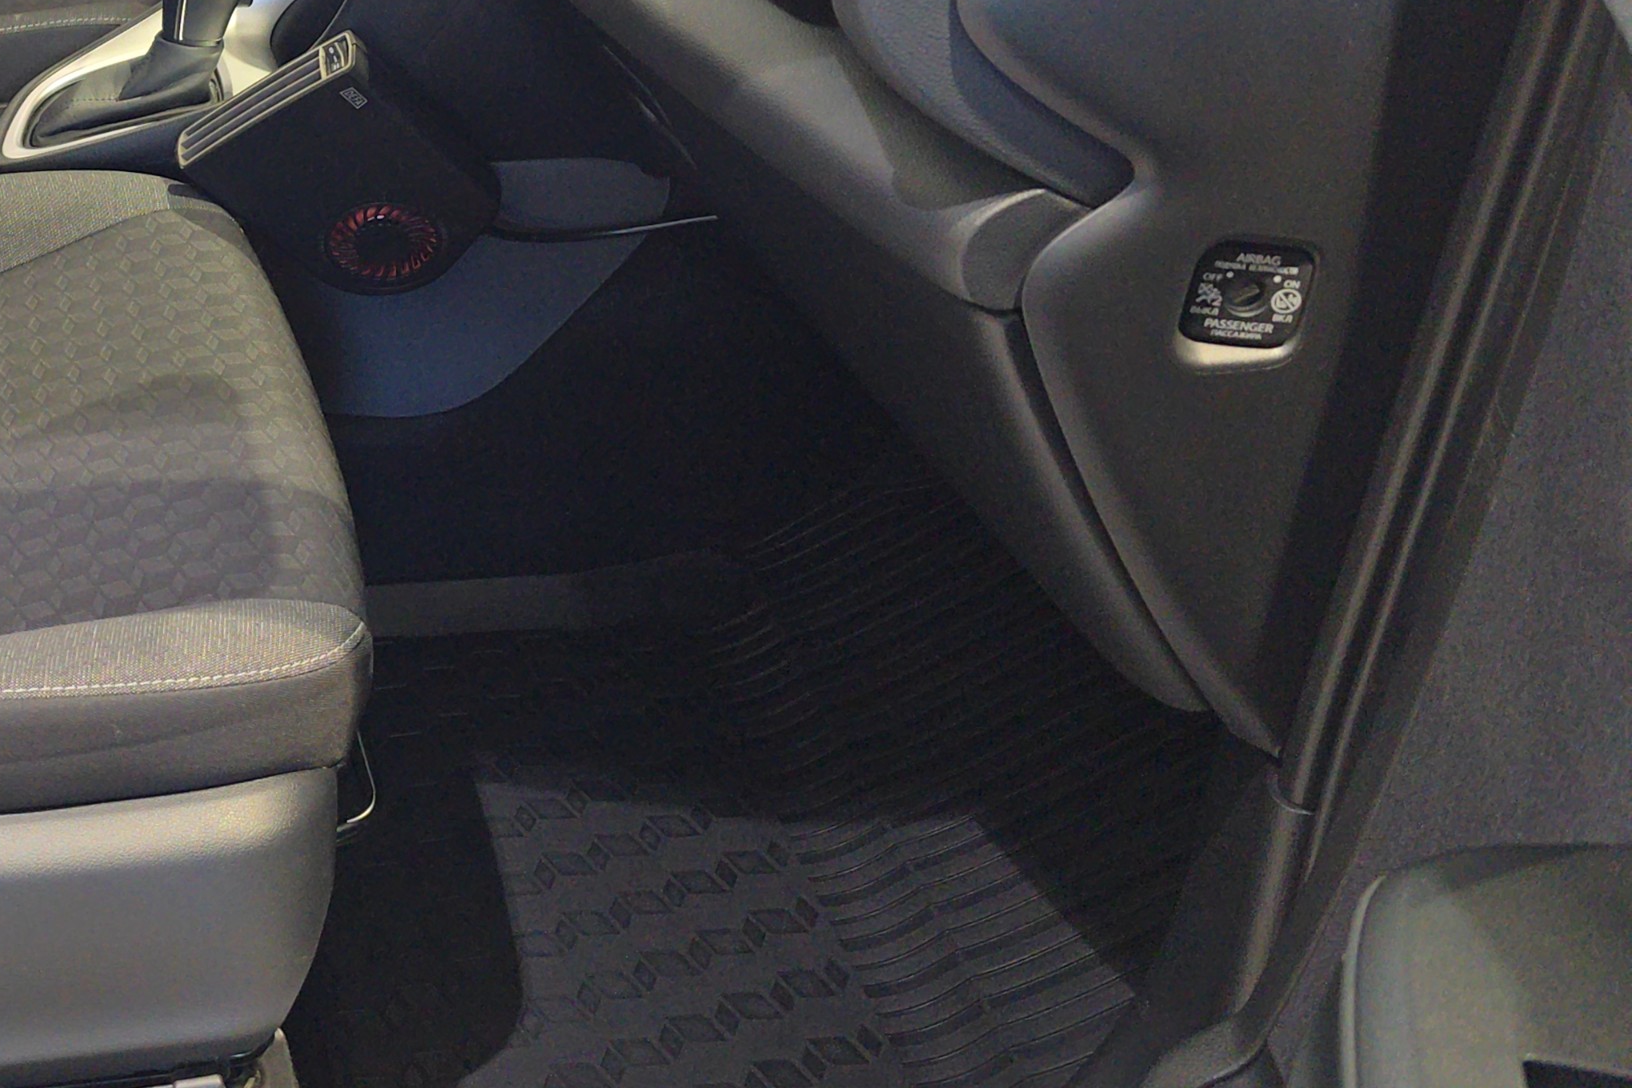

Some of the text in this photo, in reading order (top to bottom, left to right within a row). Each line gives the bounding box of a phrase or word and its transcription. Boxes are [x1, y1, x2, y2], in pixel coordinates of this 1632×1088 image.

[1236, 253, 1281, 266] AIRBAG
[1203, 272, 1223, 282] OFF
[1284, 280, 1300, 289] ON
[1204, 317, 1274, 334] PASSENGER
